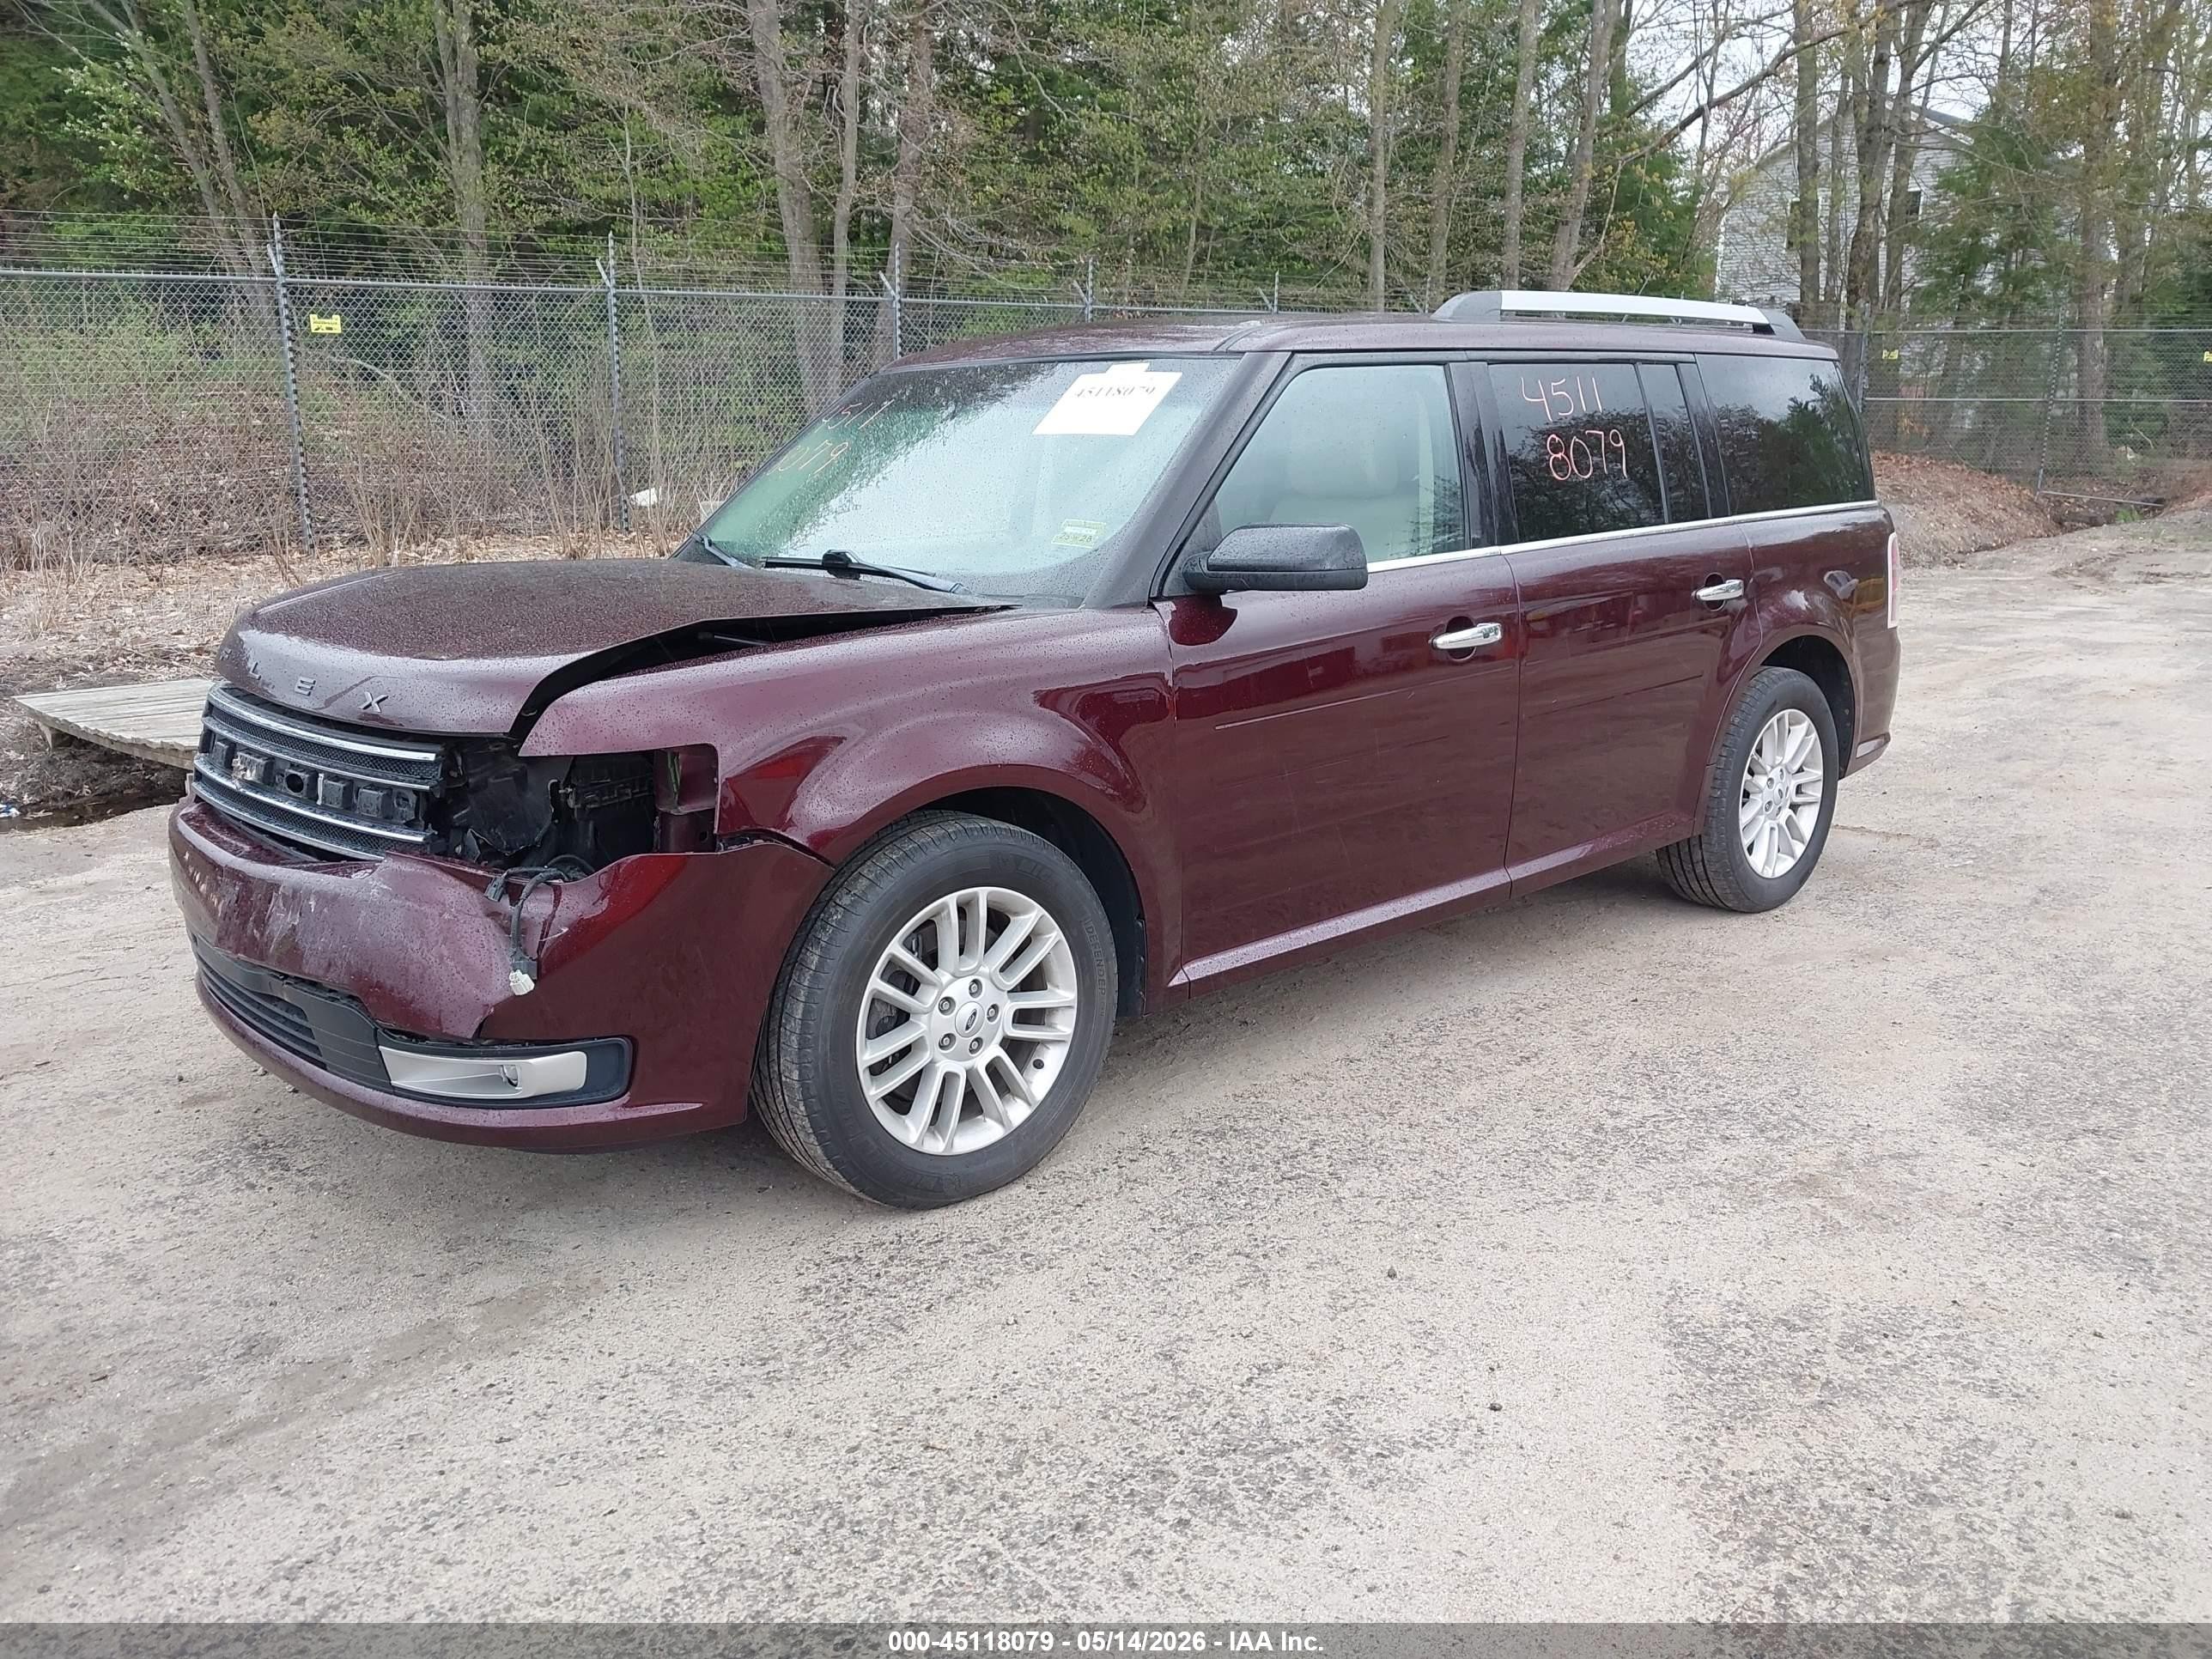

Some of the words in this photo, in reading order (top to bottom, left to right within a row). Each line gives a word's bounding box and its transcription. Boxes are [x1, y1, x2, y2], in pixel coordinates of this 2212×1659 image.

[1521, 376, 1602, 422] 4511
[766, 439, 848, 477] 079
[1547, 429, 1627, 481] 8079
